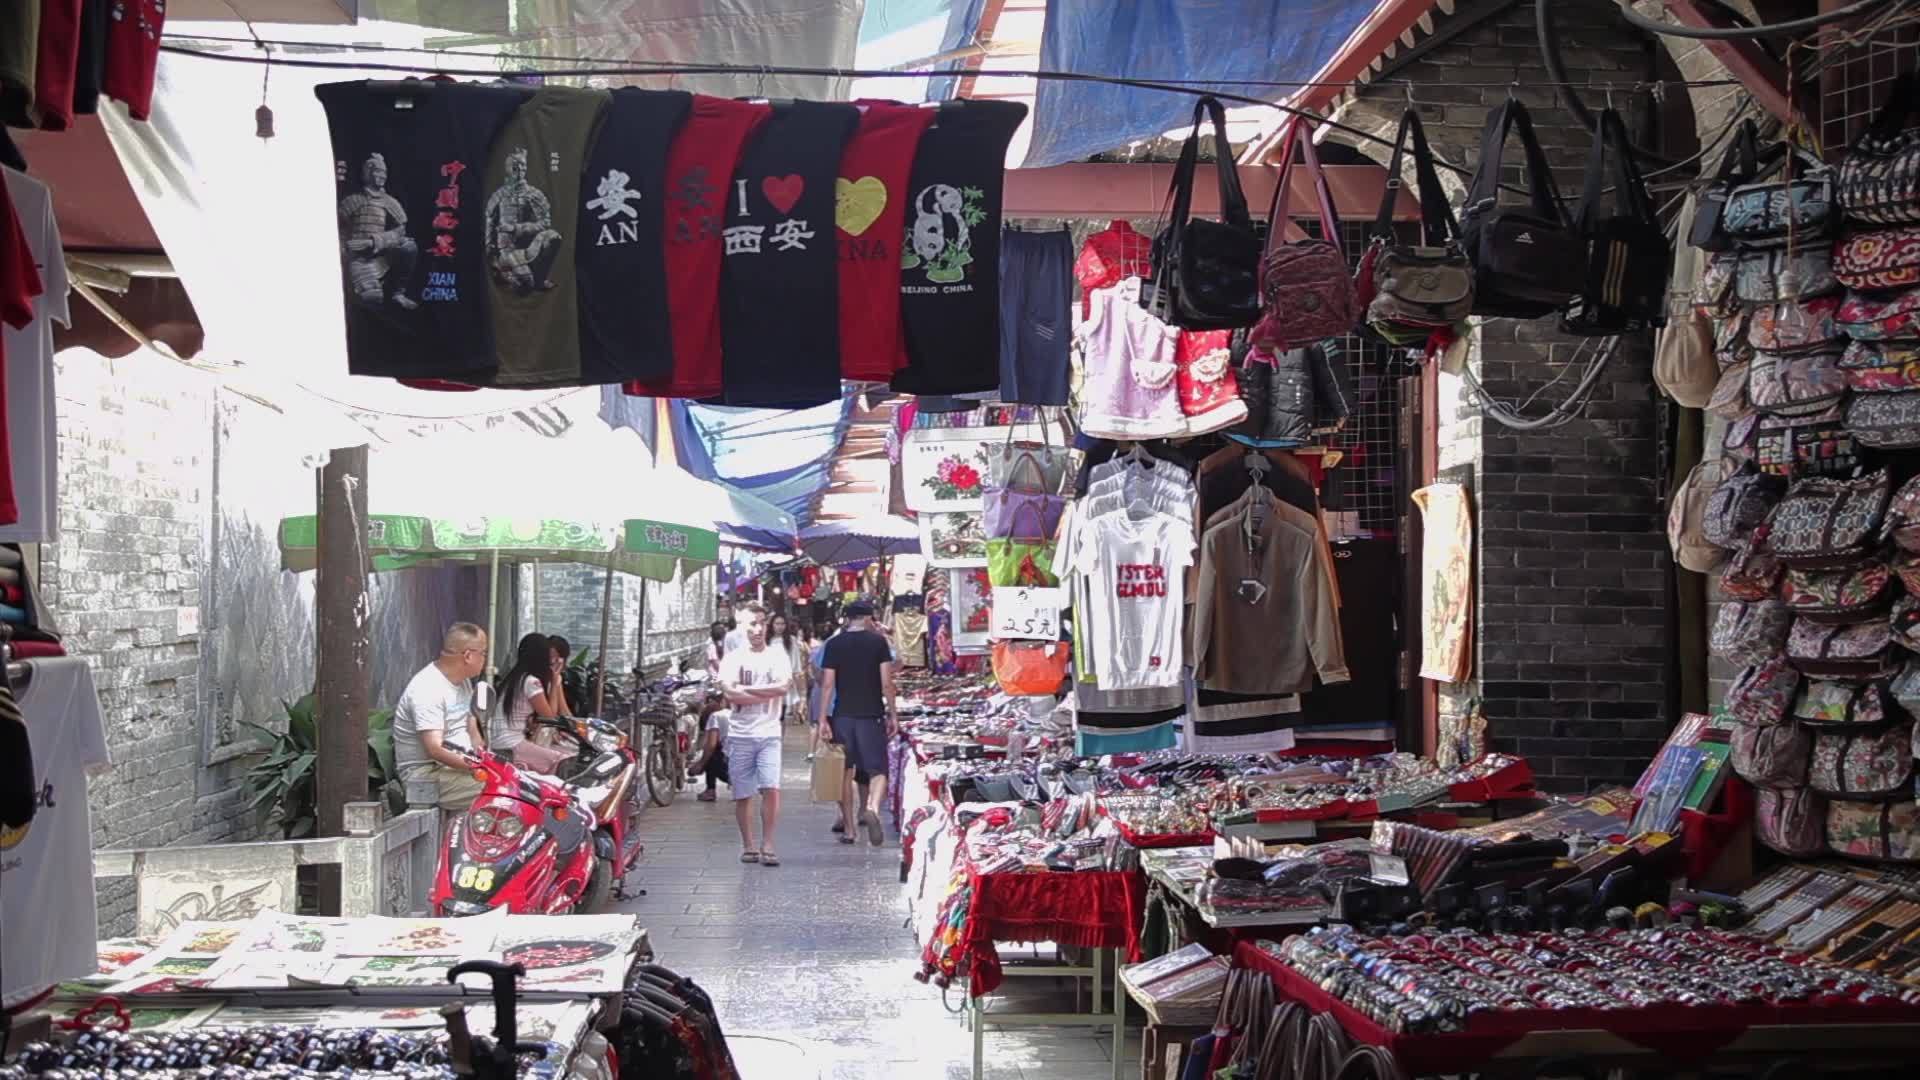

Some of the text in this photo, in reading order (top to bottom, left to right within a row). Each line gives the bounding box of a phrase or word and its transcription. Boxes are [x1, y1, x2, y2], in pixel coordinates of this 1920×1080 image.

[585, 168, 642, 220] 安
[735, 178, 751, 216] I
[595, 220, 640, 246] AN
[722, 218, 816, 256] 西安
[427, 271, 457, 286] XIAN
[900, 283, 974, 295] BEIJING CHINA
[421, 287, 459, 301] CHINA
